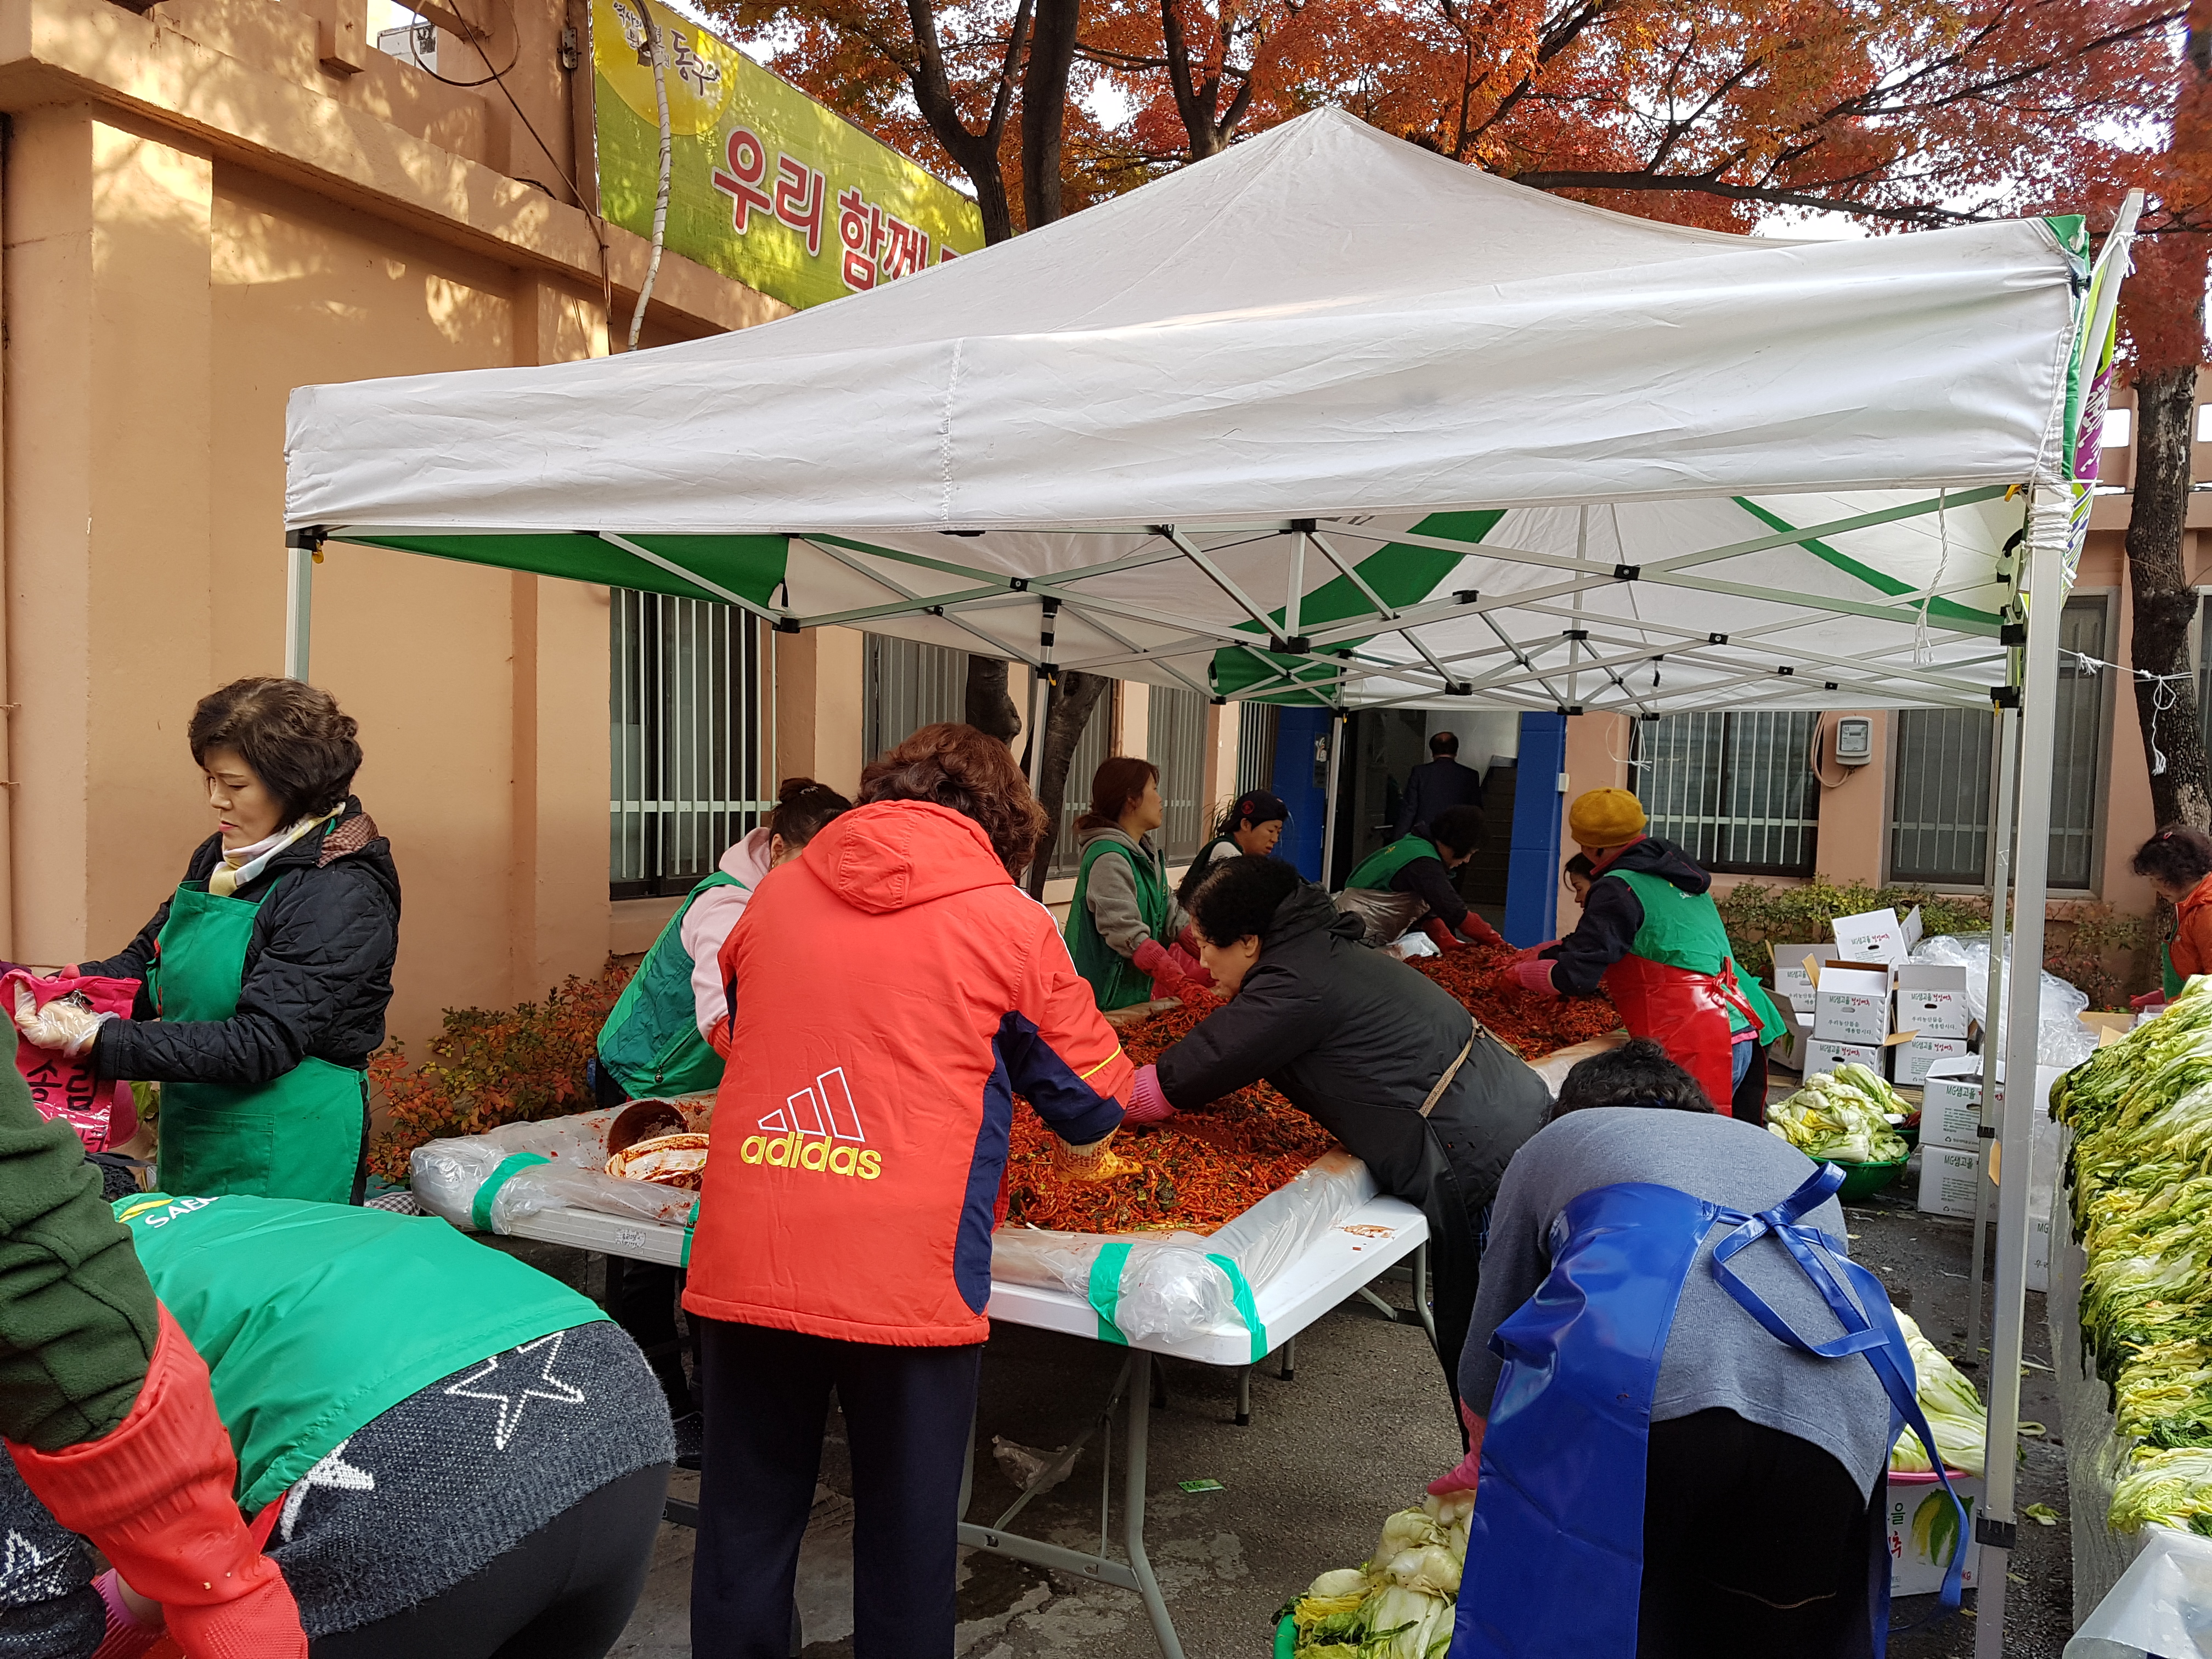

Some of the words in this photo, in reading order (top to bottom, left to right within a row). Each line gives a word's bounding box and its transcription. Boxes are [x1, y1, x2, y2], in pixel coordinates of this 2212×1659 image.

[670, 29, 716, 96] 동구
[714, 126, 826, 256] 우리
[838, 185, 929, 292] 함께
[1946, 1085, 1976, 1100] MG샘고을
[740, 1132, 882, 1180] adidas
[1944, 1155, 1973, 1170] MG샘고을
